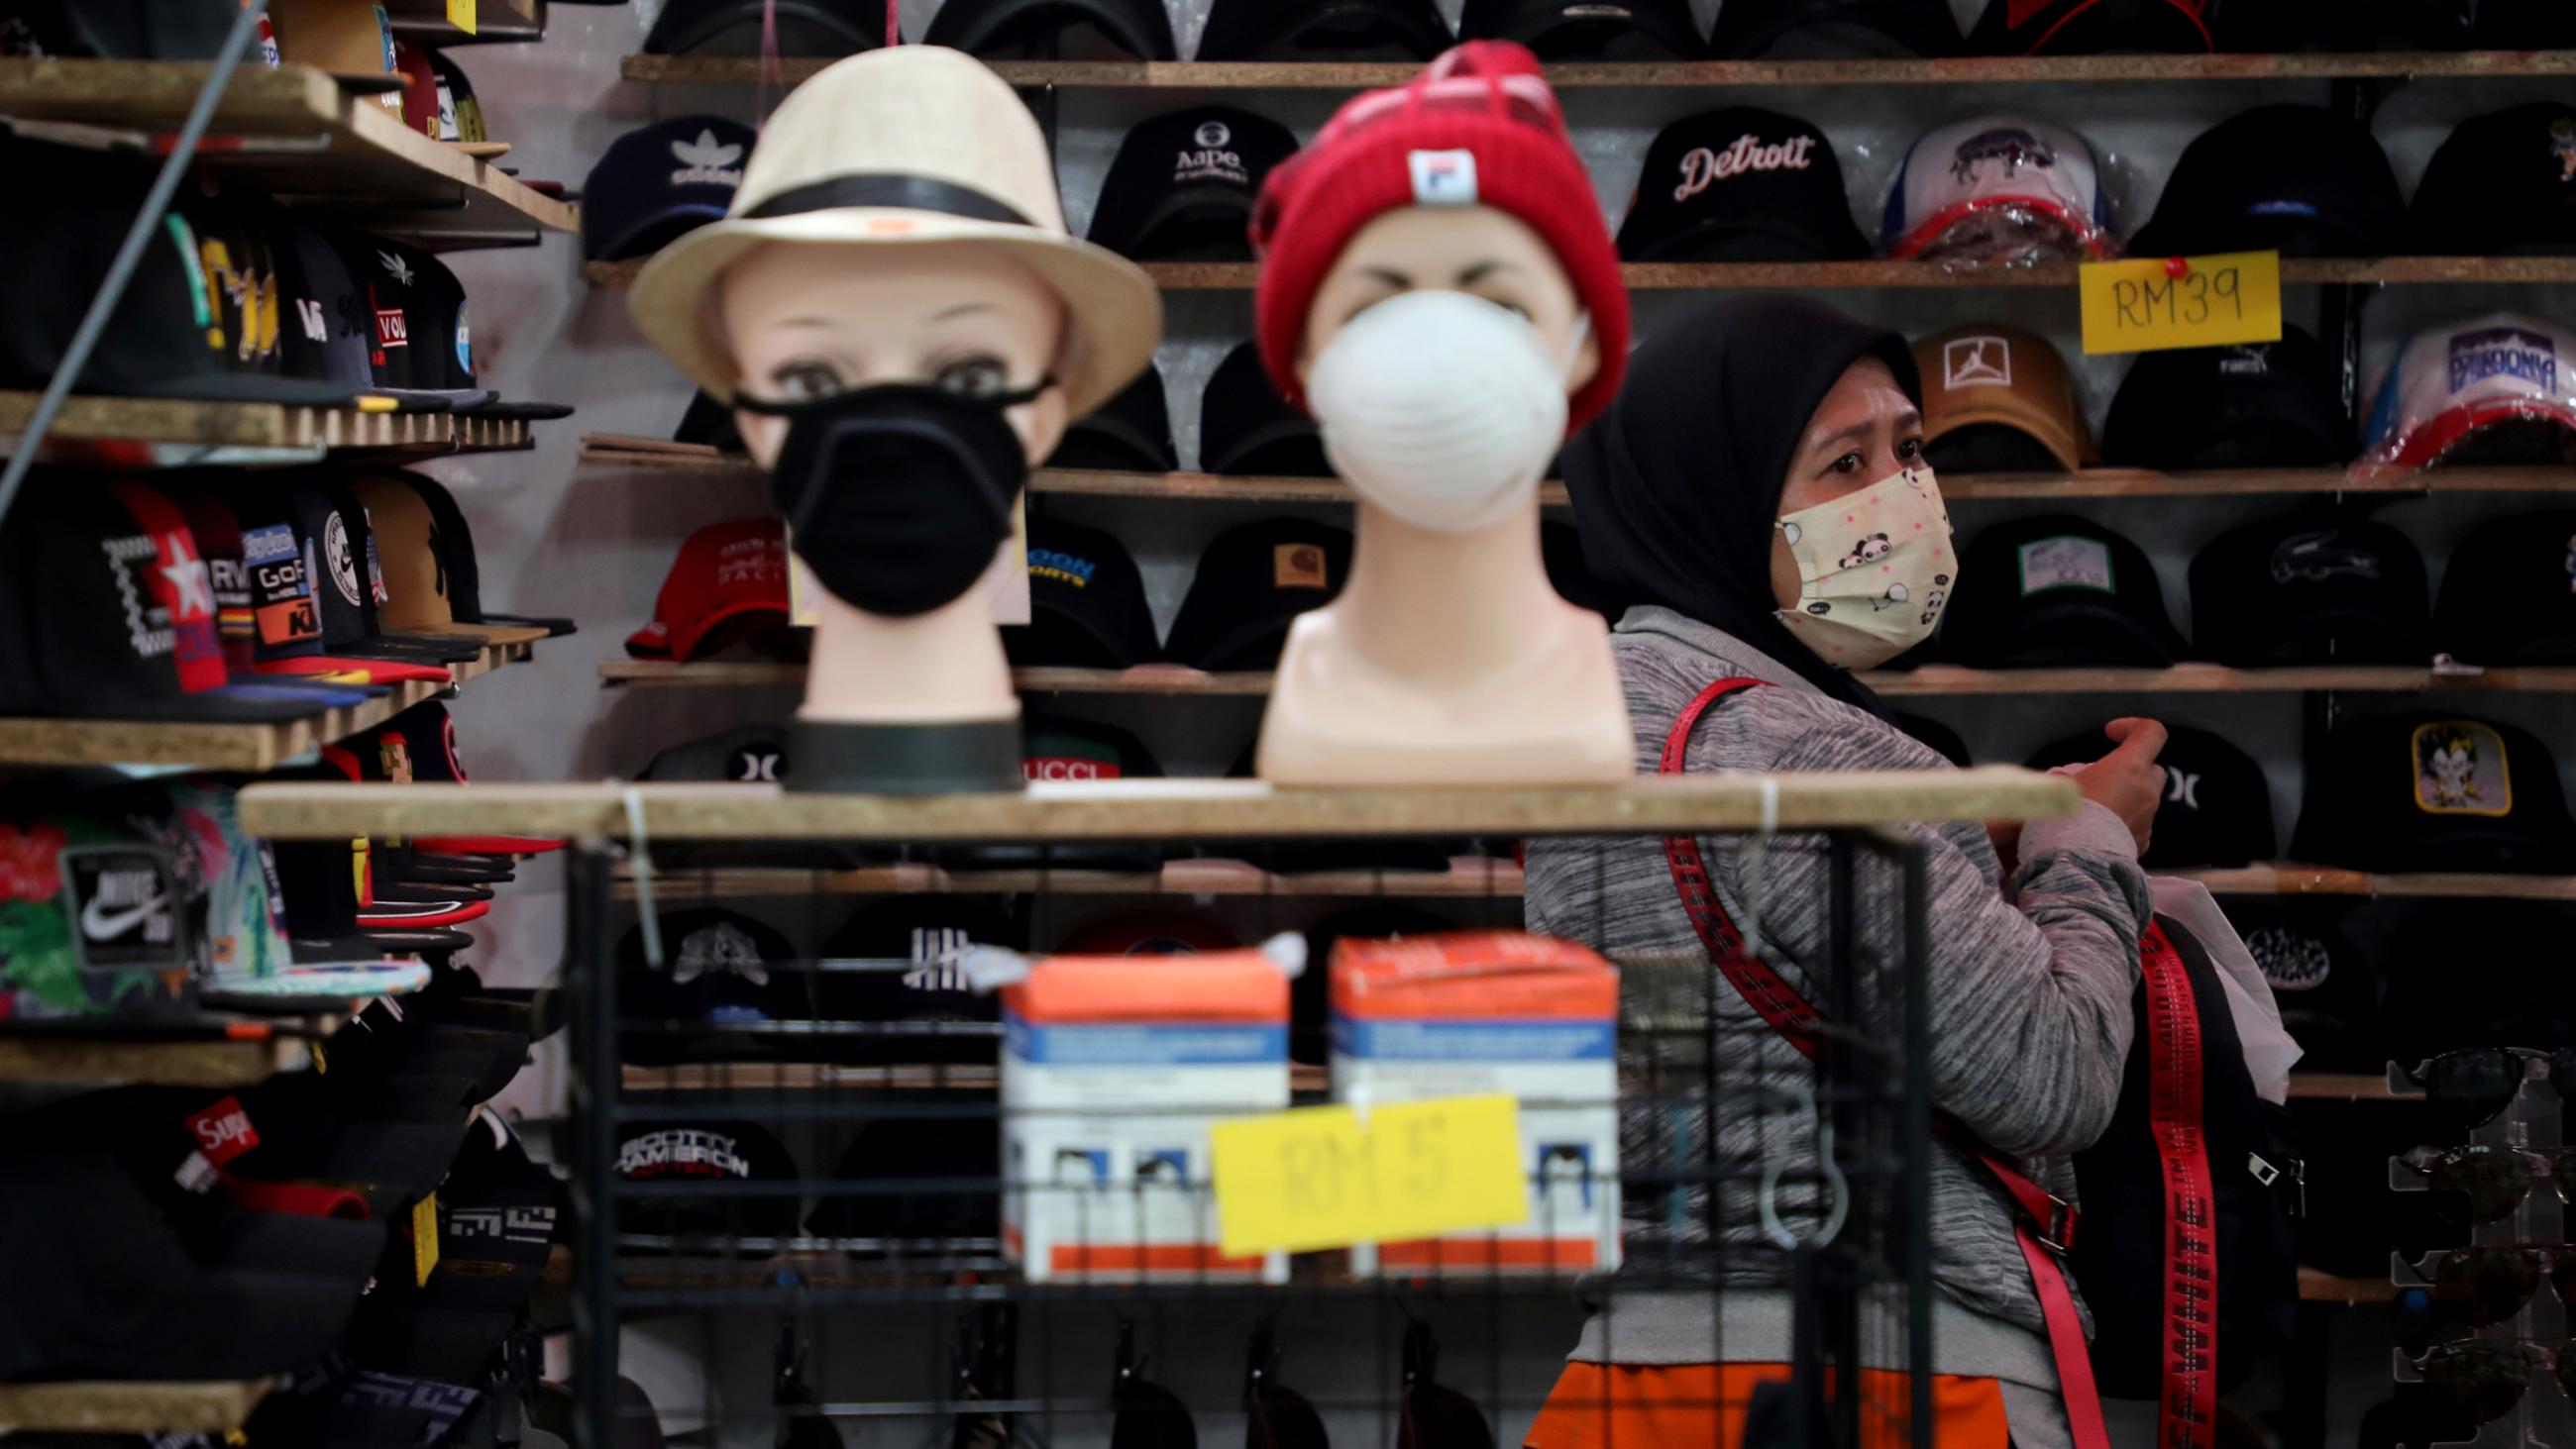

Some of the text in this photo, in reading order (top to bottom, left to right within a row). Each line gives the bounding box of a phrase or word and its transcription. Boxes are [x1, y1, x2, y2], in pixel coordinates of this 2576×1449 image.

[1176, 150, 1240, 169] Aape
[1673, 133, 1816, 202] Detroit
[2112, 266, 2243, 329] RM39
